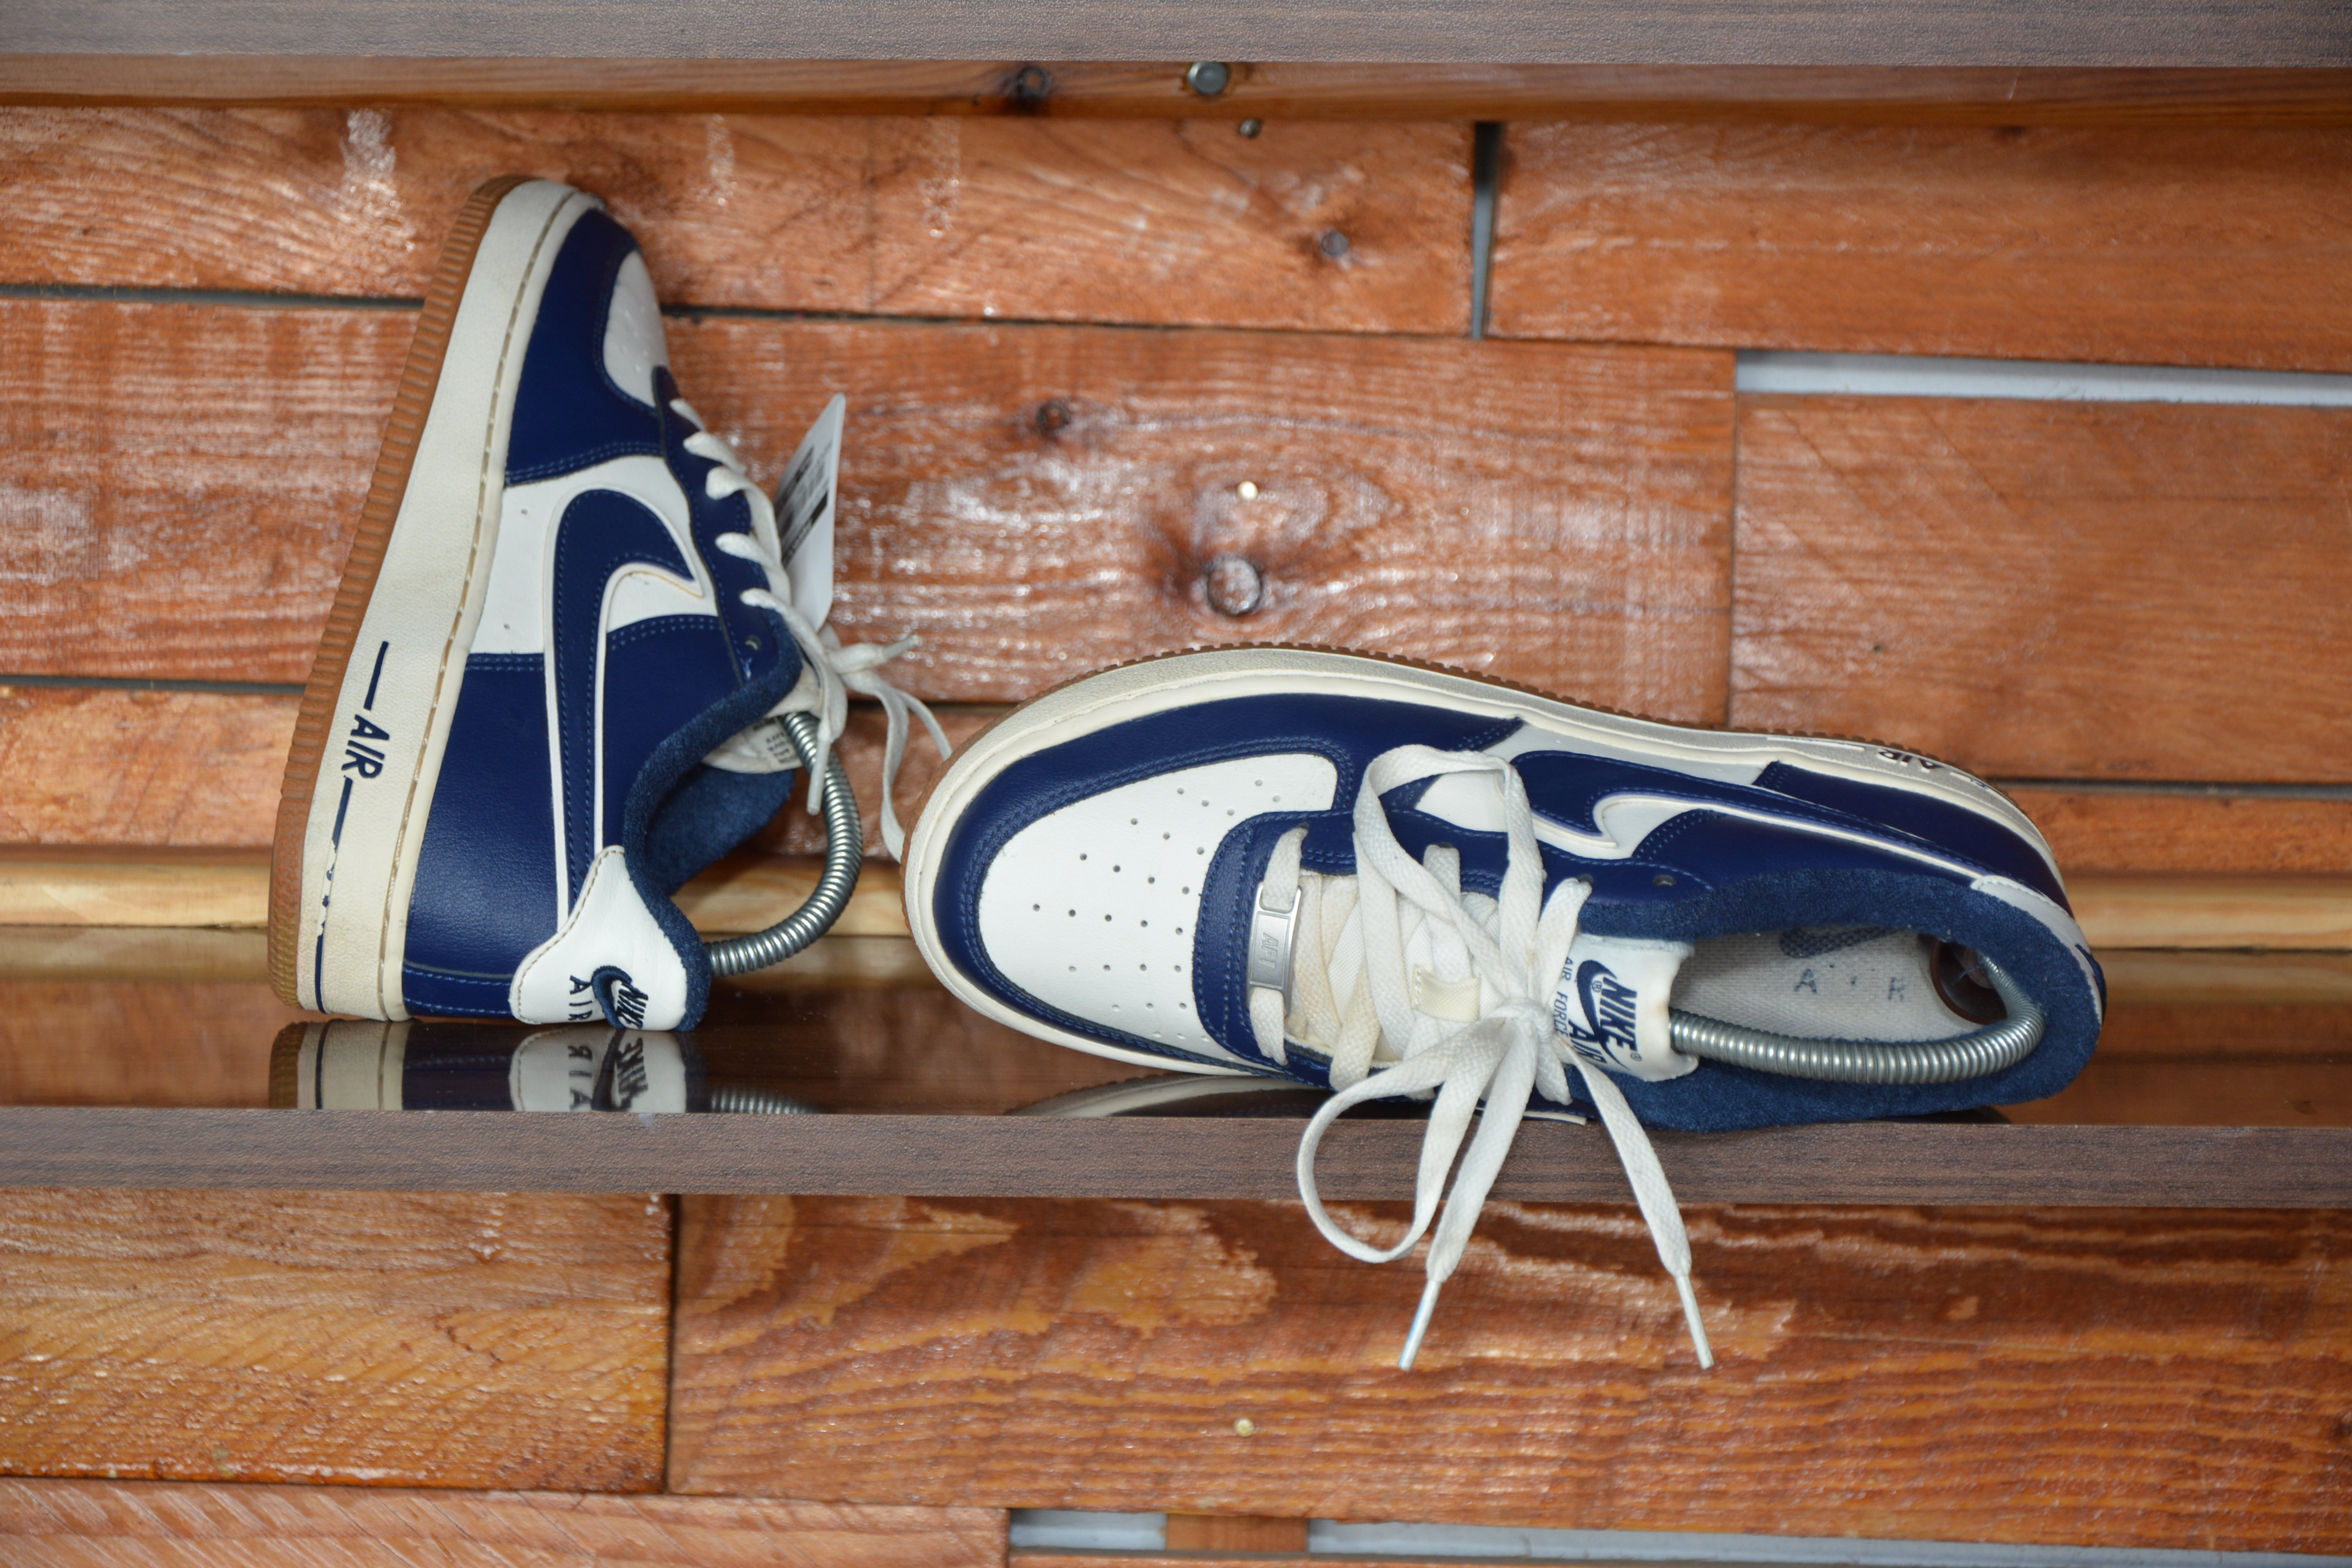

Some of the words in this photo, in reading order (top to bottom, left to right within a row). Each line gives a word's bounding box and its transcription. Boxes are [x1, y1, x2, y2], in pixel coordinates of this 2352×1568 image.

[341, 714, 390, 778] AIR
[569, 975, 592, 1020] AIR
[1600, 977, 1637, 1052] NIKE
[1569, 1020, 1607, 1063] AIR
